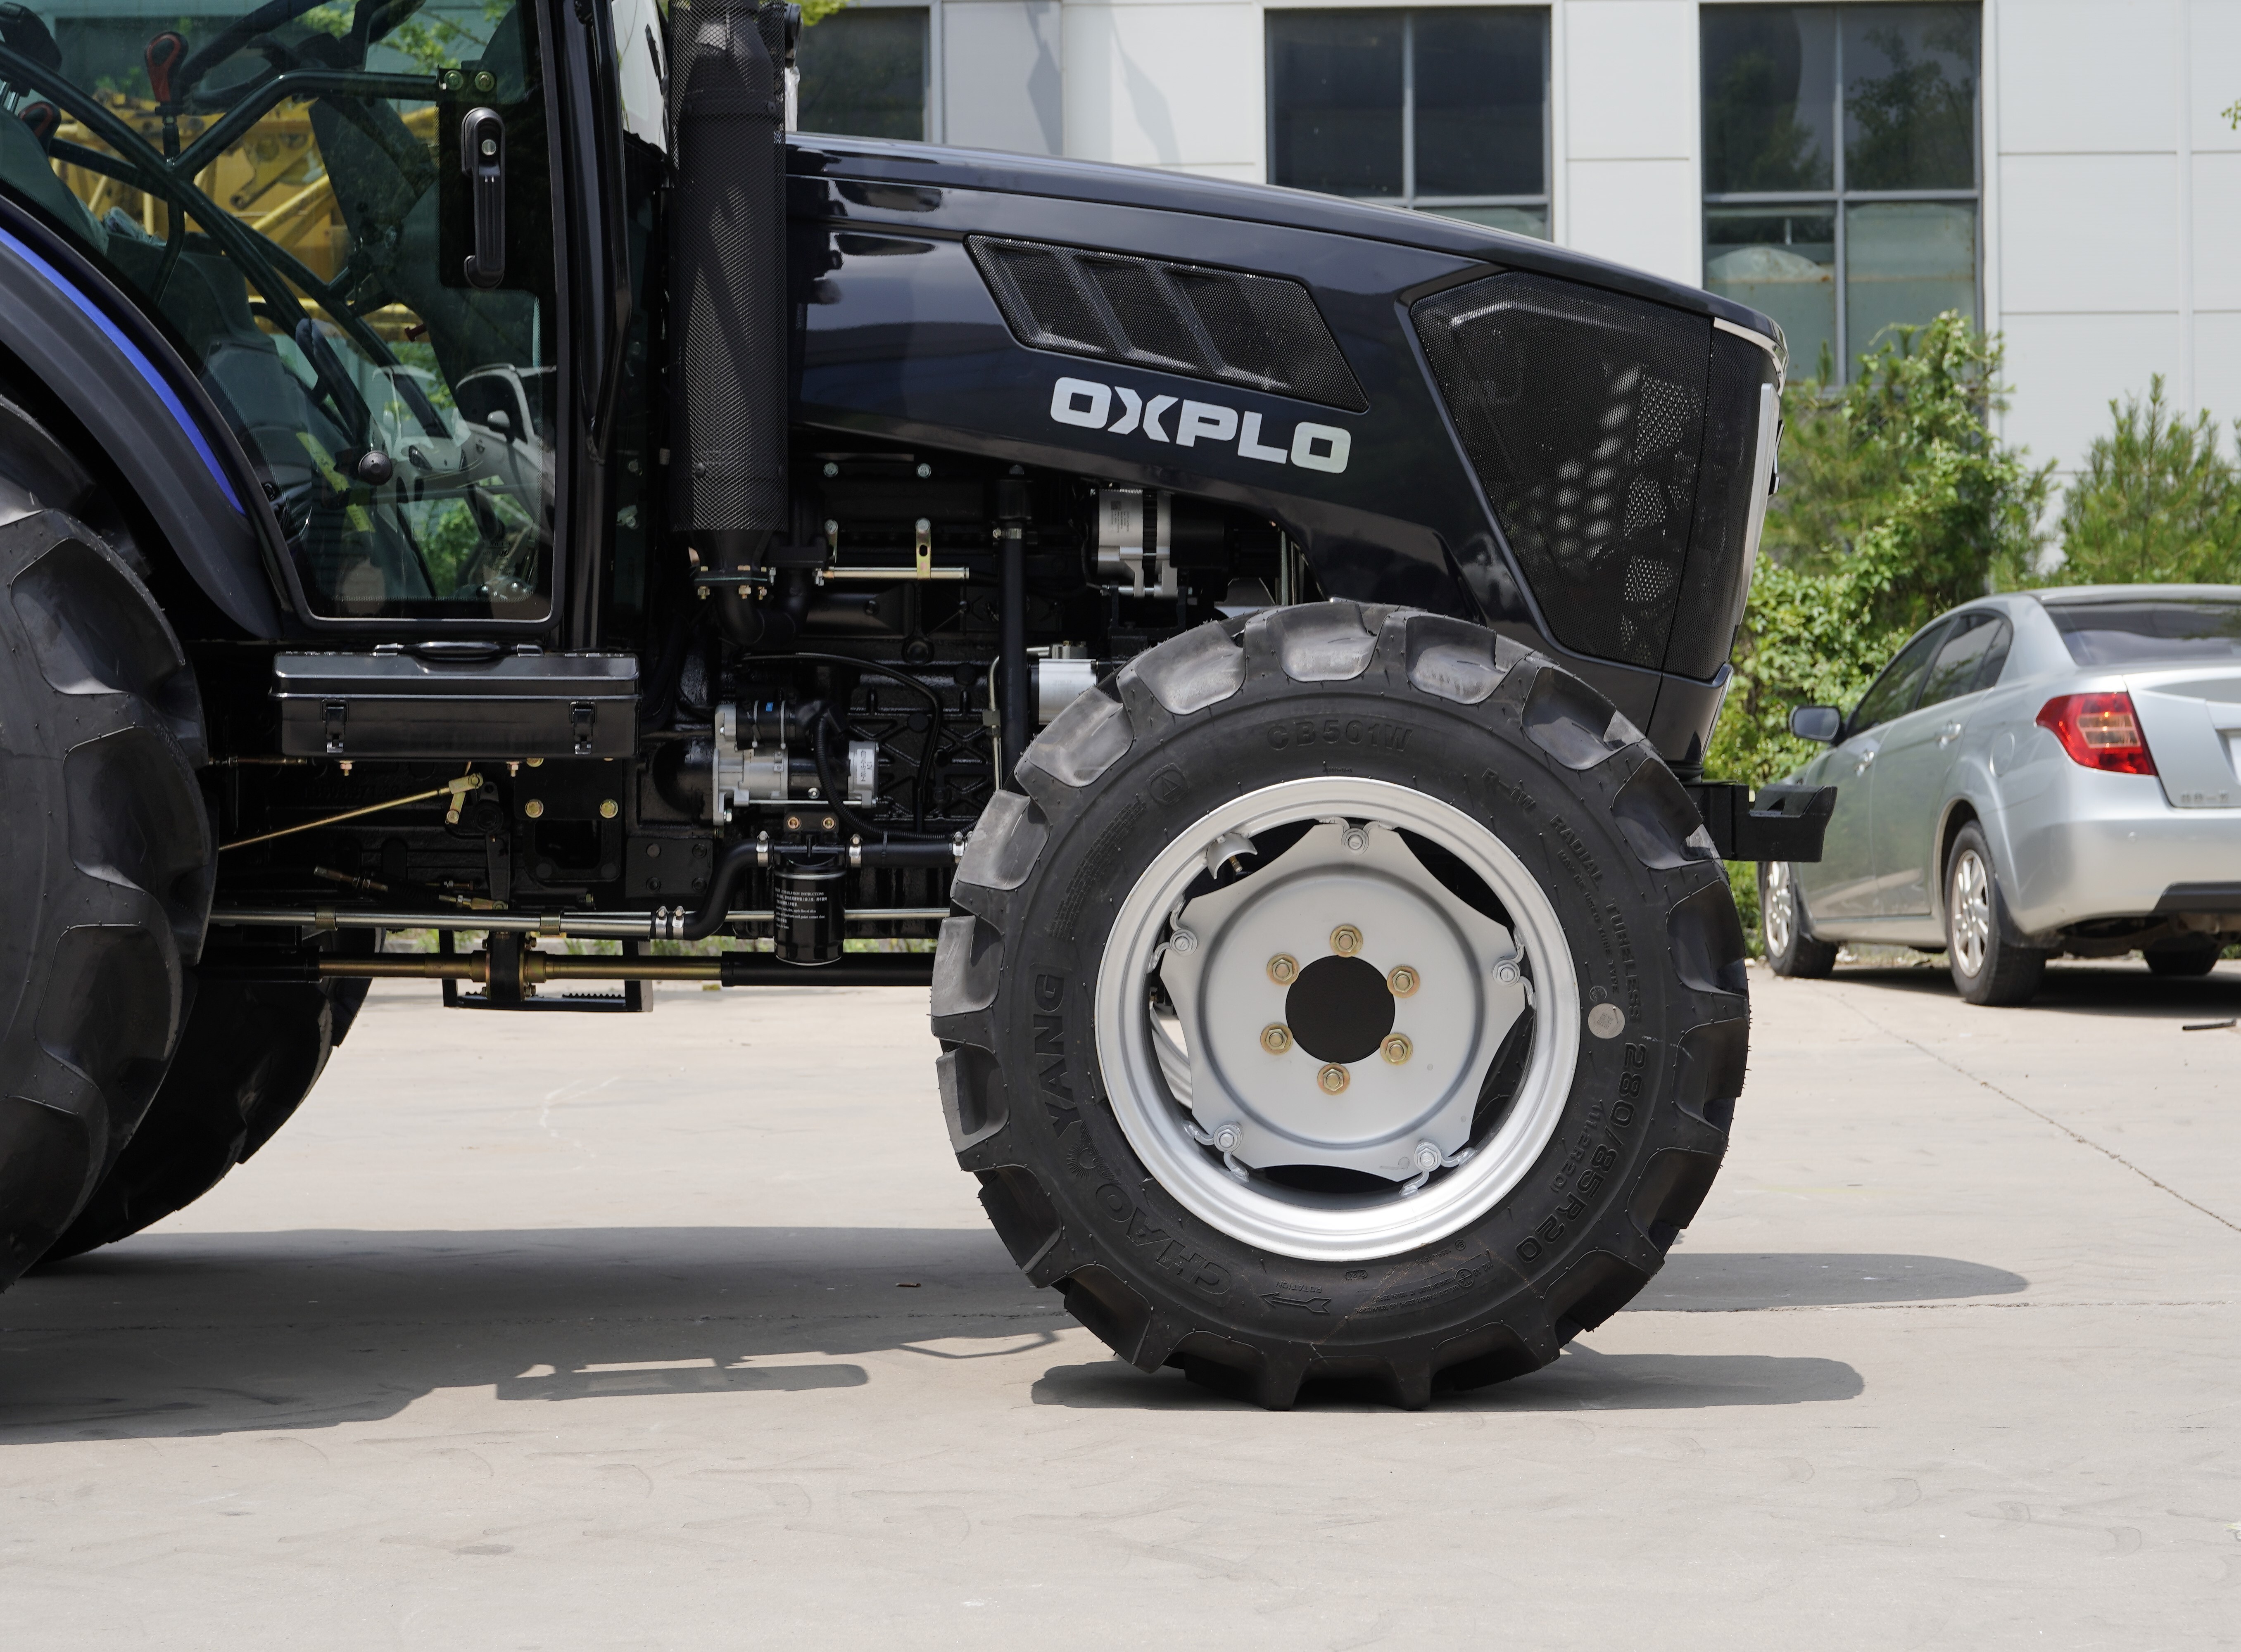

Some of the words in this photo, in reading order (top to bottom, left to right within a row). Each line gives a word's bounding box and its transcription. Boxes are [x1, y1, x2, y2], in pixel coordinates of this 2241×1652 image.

[1050, 377, 1351, 474] OXPLO
[1264, 718, 1414, 754] CB501W
[1547, 812, 1605, 885] RADIAL
[1603, 899, 1641, 1020] TUBELESS
[1556, 848, 1575, 871] MAY
[1607, 959, 1618, 992] TYPE
[1032, 972, 1086, 1139] YANG
[1511, 1042, 1649, 1266] 280/85R20
[1547, 1103, 1603, 1195] (11.2R20)
[1089, 1176, 1236, 1300] CHAO
[1275, 1279, 1322, 1293] ROTATION
